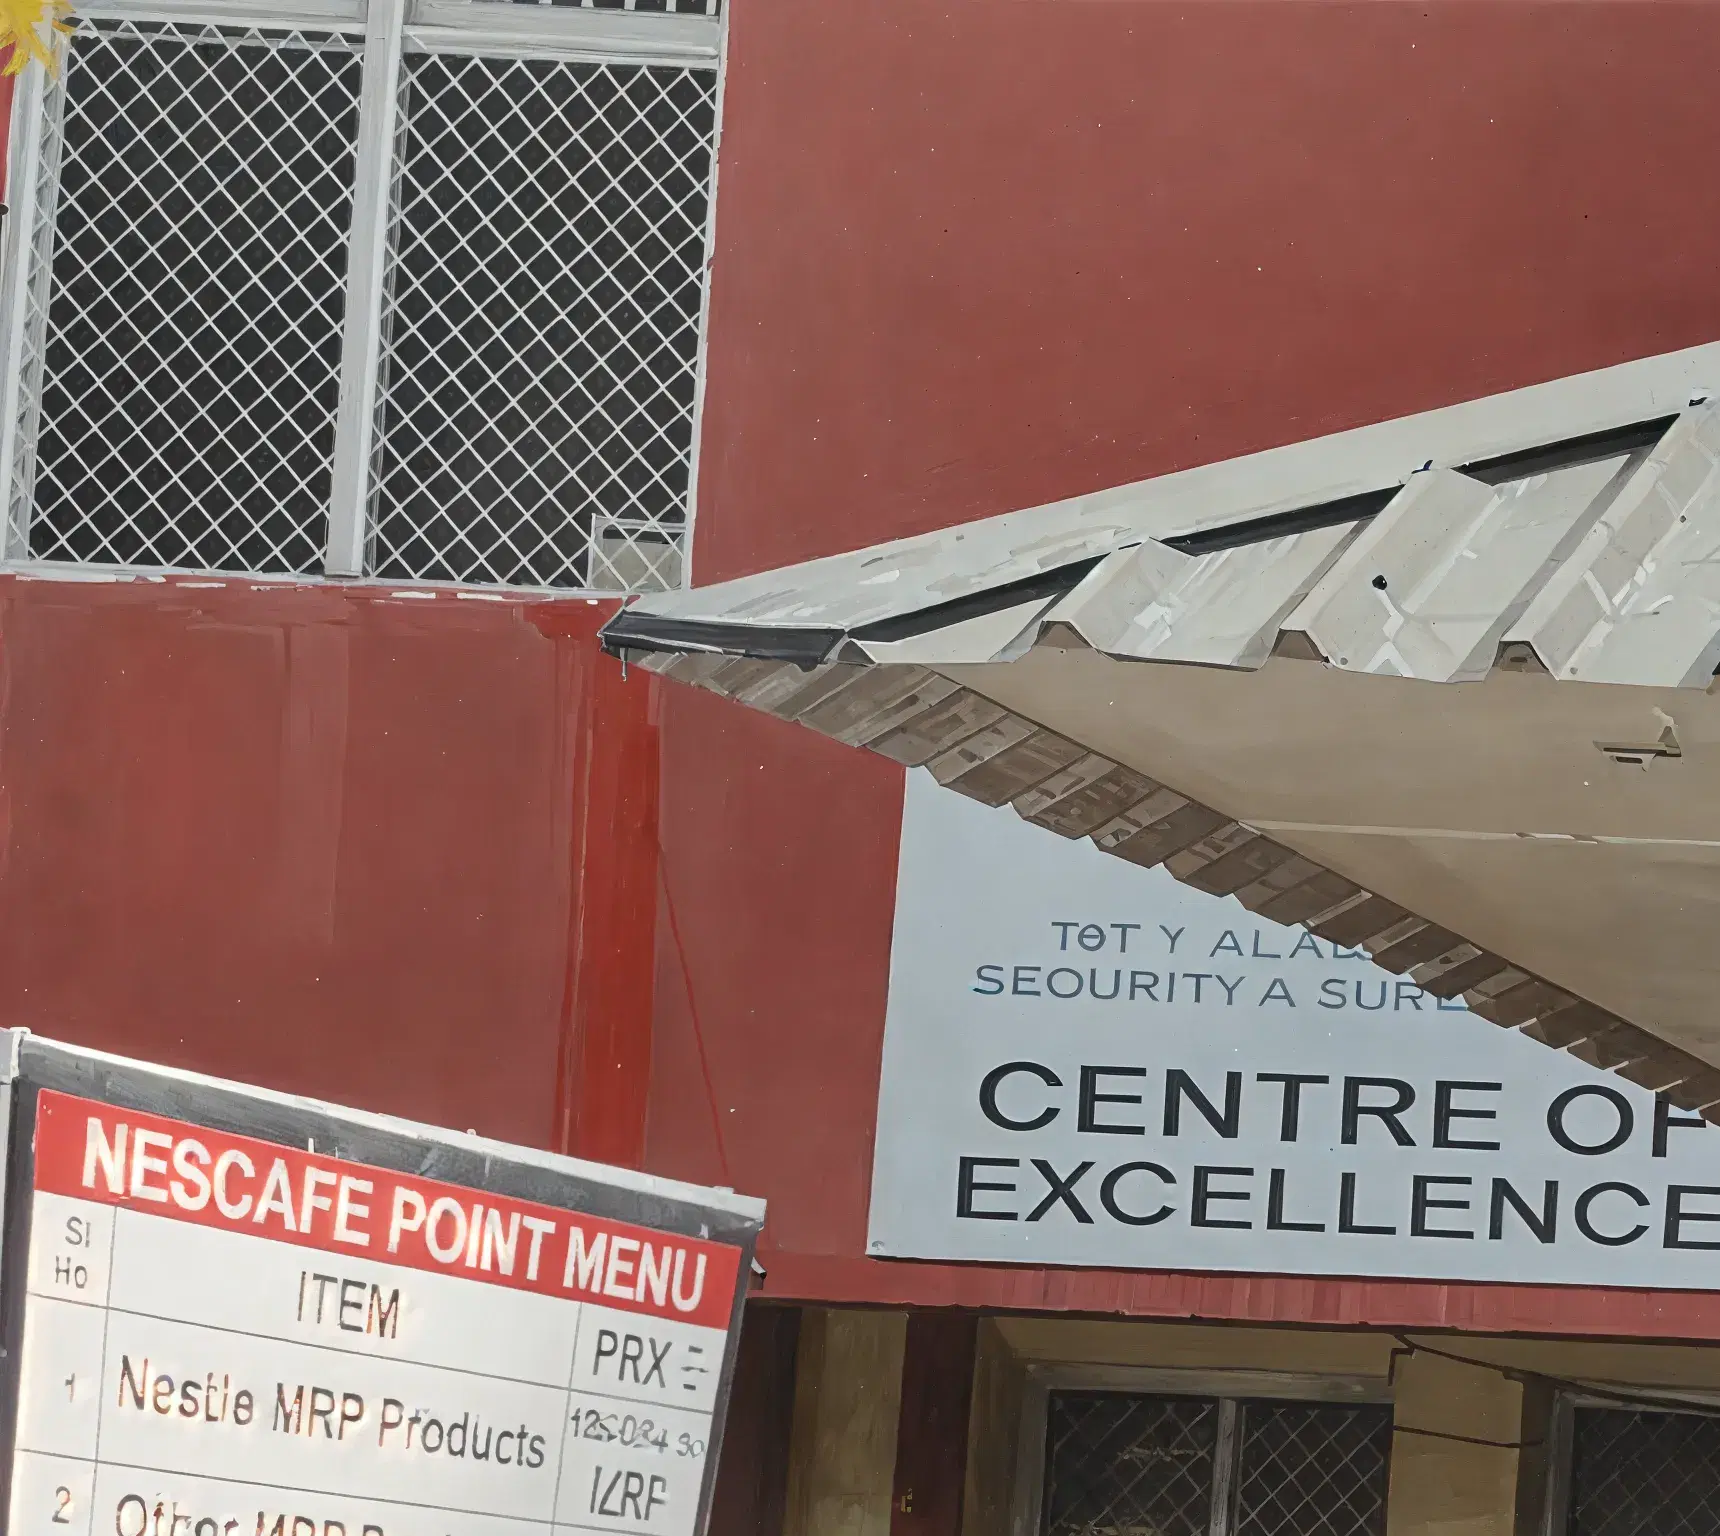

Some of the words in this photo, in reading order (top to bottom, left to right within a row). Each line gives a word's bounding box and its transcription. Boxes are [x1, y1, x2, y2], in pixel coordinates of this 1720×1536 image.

[978, 1060, 1504, 1154] CENTRE
[1545, 1081, 1708, 1160] OF
[82, 1117, 376, 1245] NESCAFE
[387, 1185, 555, 1280] POINT
[562, 1231, 708, 1313] MENU
[297, 1271, 400, 1339] ITEM
[273, 1382, 364, 1441] MRP
[379, 1398, 546, 1469] Products
[52, 1485, 72, 1525] 2
